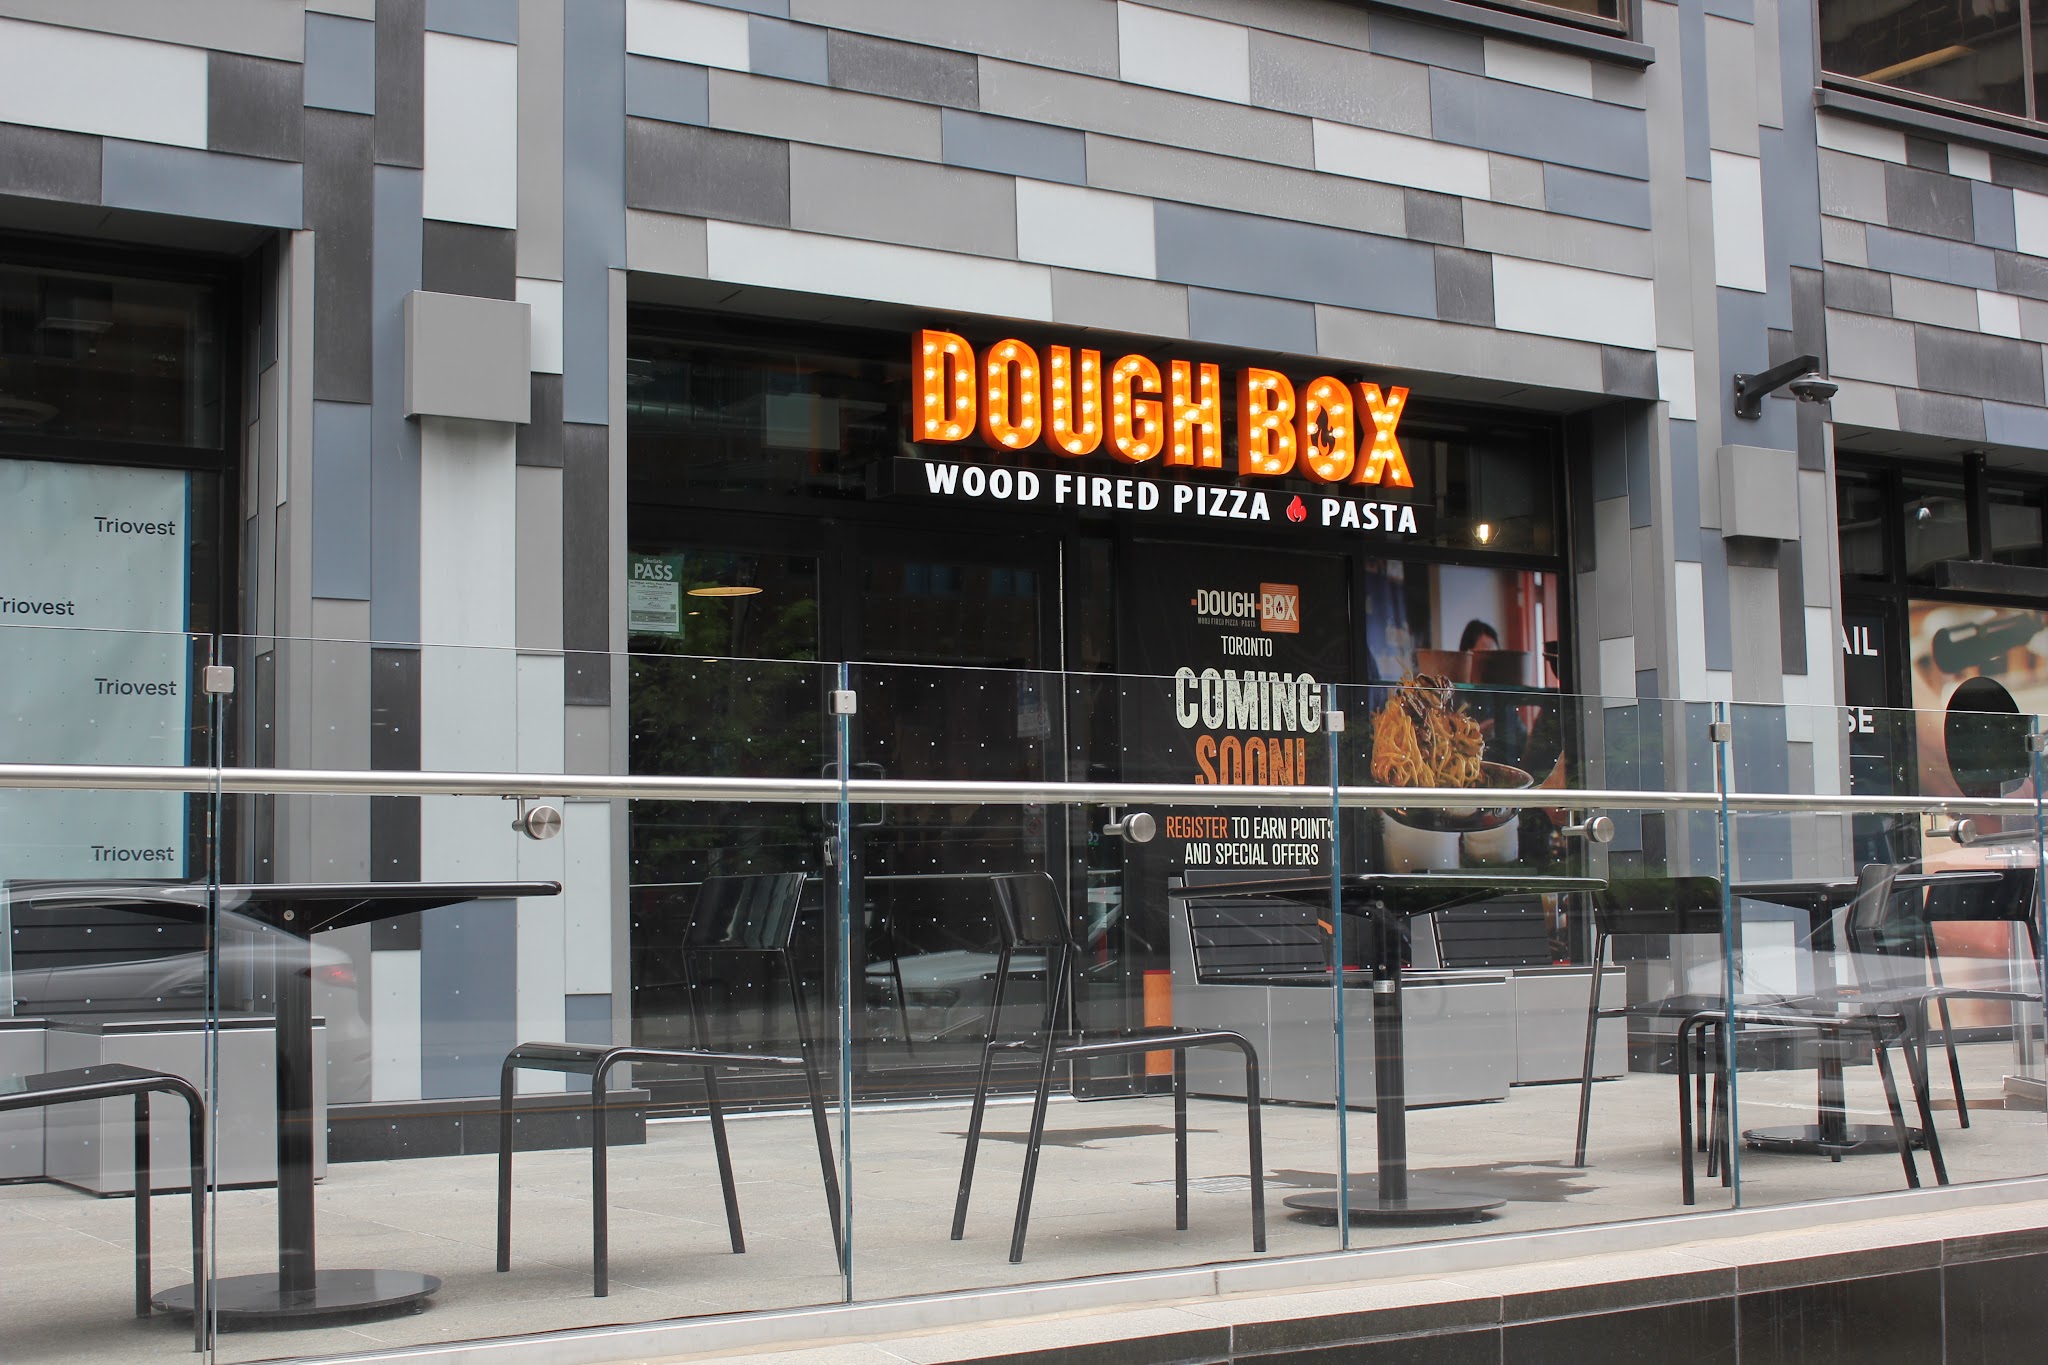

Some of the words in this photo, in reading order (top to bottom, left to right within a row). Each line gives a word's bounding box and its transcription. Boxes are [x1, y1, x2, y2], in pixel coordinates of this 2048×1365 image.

[913, 329, 1222, 468] DOUGH
[1238, 367, 1414, 488] BOX
[925, 463, 1040, 501] WOOD
[1055, 474, 1159, 511] FIRED
[1173, 486, 1270, 521] PIZZA
[1321, 499, 1418, 534] PASTA
[94, 517, 176, 535] Triovest
[634, 563, 673, 580] PASS
[0, 597, 75, 615] riovest
[1197, 589, 1256, 618] DOUGH
[1262, 593, 1298, 621] BOX
[1221, 635, 1273, 658] TORONTO
[94, 678, 177, 696] Triovest
[1174, 666, 1322, 734] COMING
[1166, 816, 1229, 839] REGISTER
[1231, 816, 1249, 840] TO
[1254, 817, 1287, 840] EARN
[91, 845, 175, 862] Triovest
[1184, 843, 1211, 865] AND
[1216, 843, 1269, 865] SPECIAL
[1272, 843, 1319, 866] OFFERS
